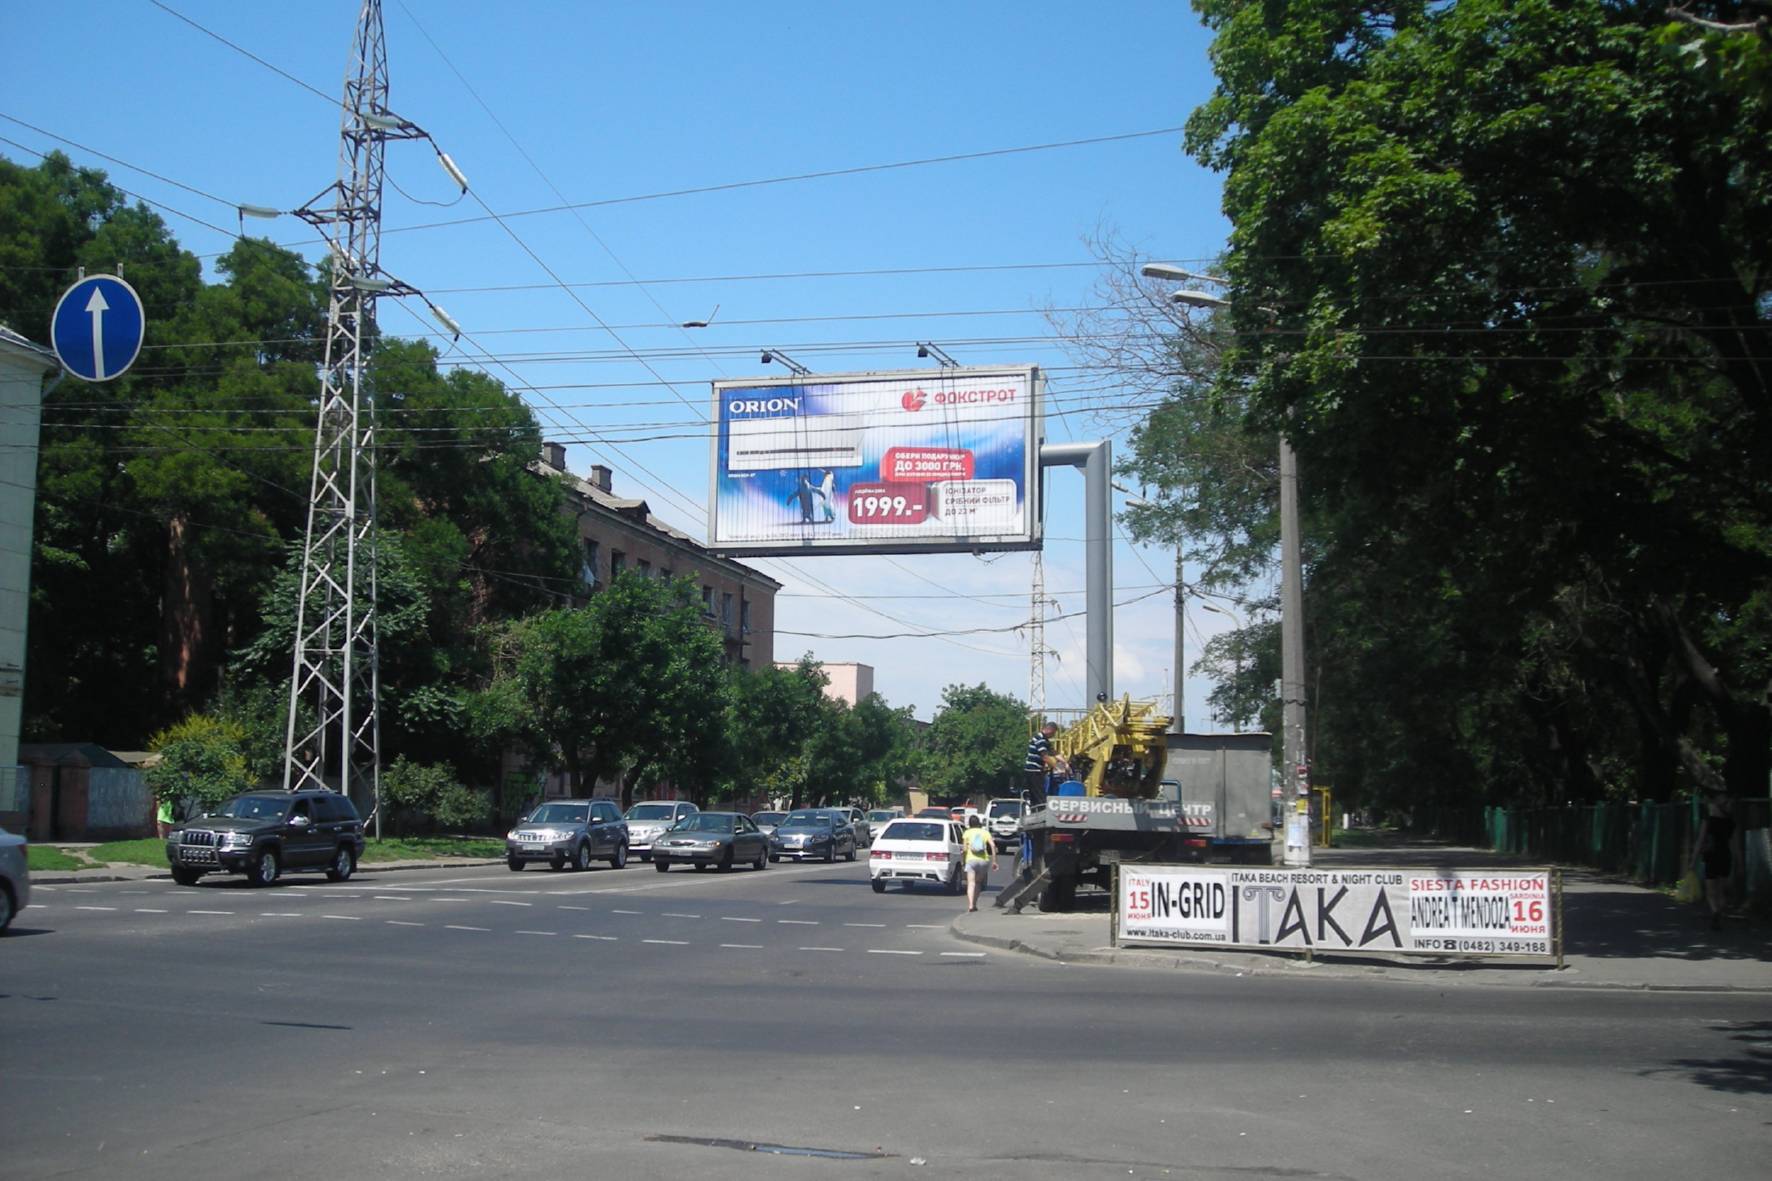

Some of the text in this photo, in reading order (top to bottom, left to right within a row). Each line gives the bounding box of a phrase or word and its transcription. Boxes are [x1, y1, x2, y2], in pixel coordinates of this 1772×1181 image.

[934, 389, 1017, 404] ФОКСТРОТ
[729, 399, 799, 413] ORION
[895, 461, 913, 471] ДО
[915, 462, 941, 471] 3000
[1231, 873, 1403, 884] ITAKA BEACH RESORT & NIGHT CLUB
[1411, 879, 1544, 891] SIESTA FASHION
[1129, 891, 1150, 909] 15
[1151, 881, 1225, 919] IN-GRID
[1231, 885, 1403, 947] ITAKA
[1411, 896, 1450, 928] ANDREA
[1461, 896, 1511, 929] MENDOZA
[1513, 901, 1543, 922] 16
[1414, 939, 1441, 949] INFO
[1459, 941, 1495, 952] (0482)
